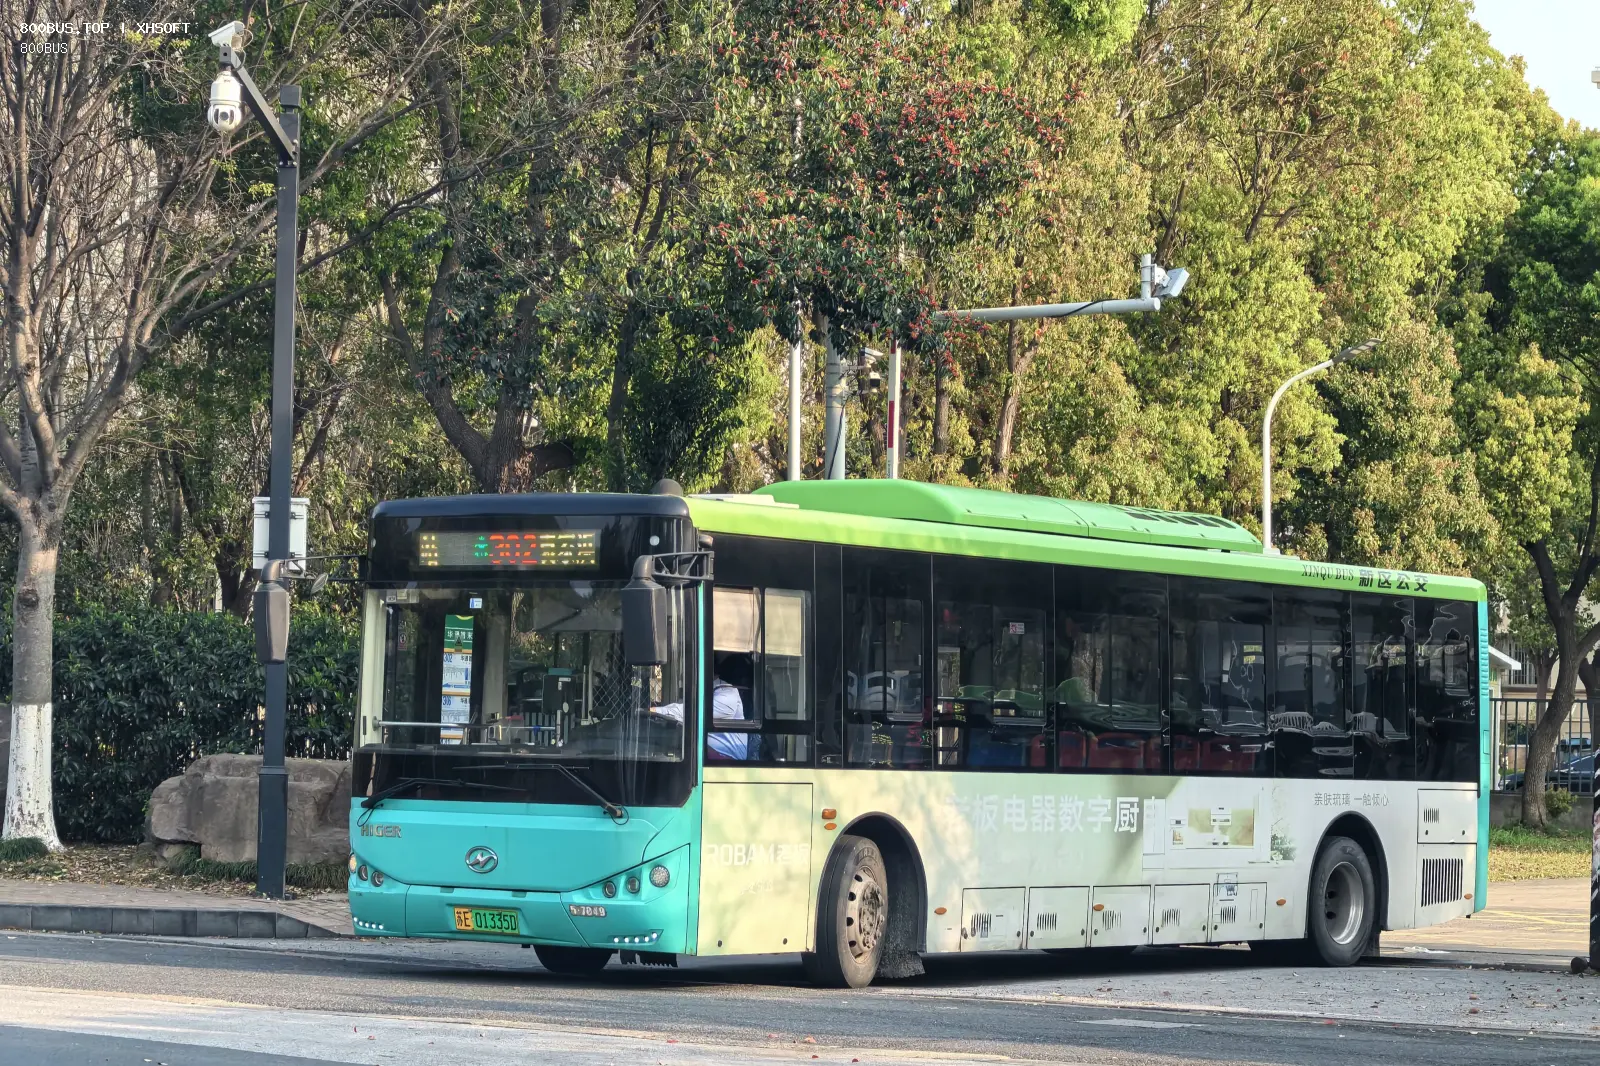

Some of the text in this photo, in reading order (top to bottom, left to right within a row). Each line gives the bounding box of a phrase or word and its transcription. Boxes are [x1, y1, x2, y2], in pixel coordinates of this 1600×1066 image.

[1301, 564, 1354, 582] XINQU BUS
[1358, 568, 1429, 593] 新区公交
[1314, 792, 1351, 806] 亲肤琉璃
[944, 794, 1166, 833] 板电器数字厨
[361, 824, 402, 838] HIGER
[474, 911, 518, 931] 01335D
